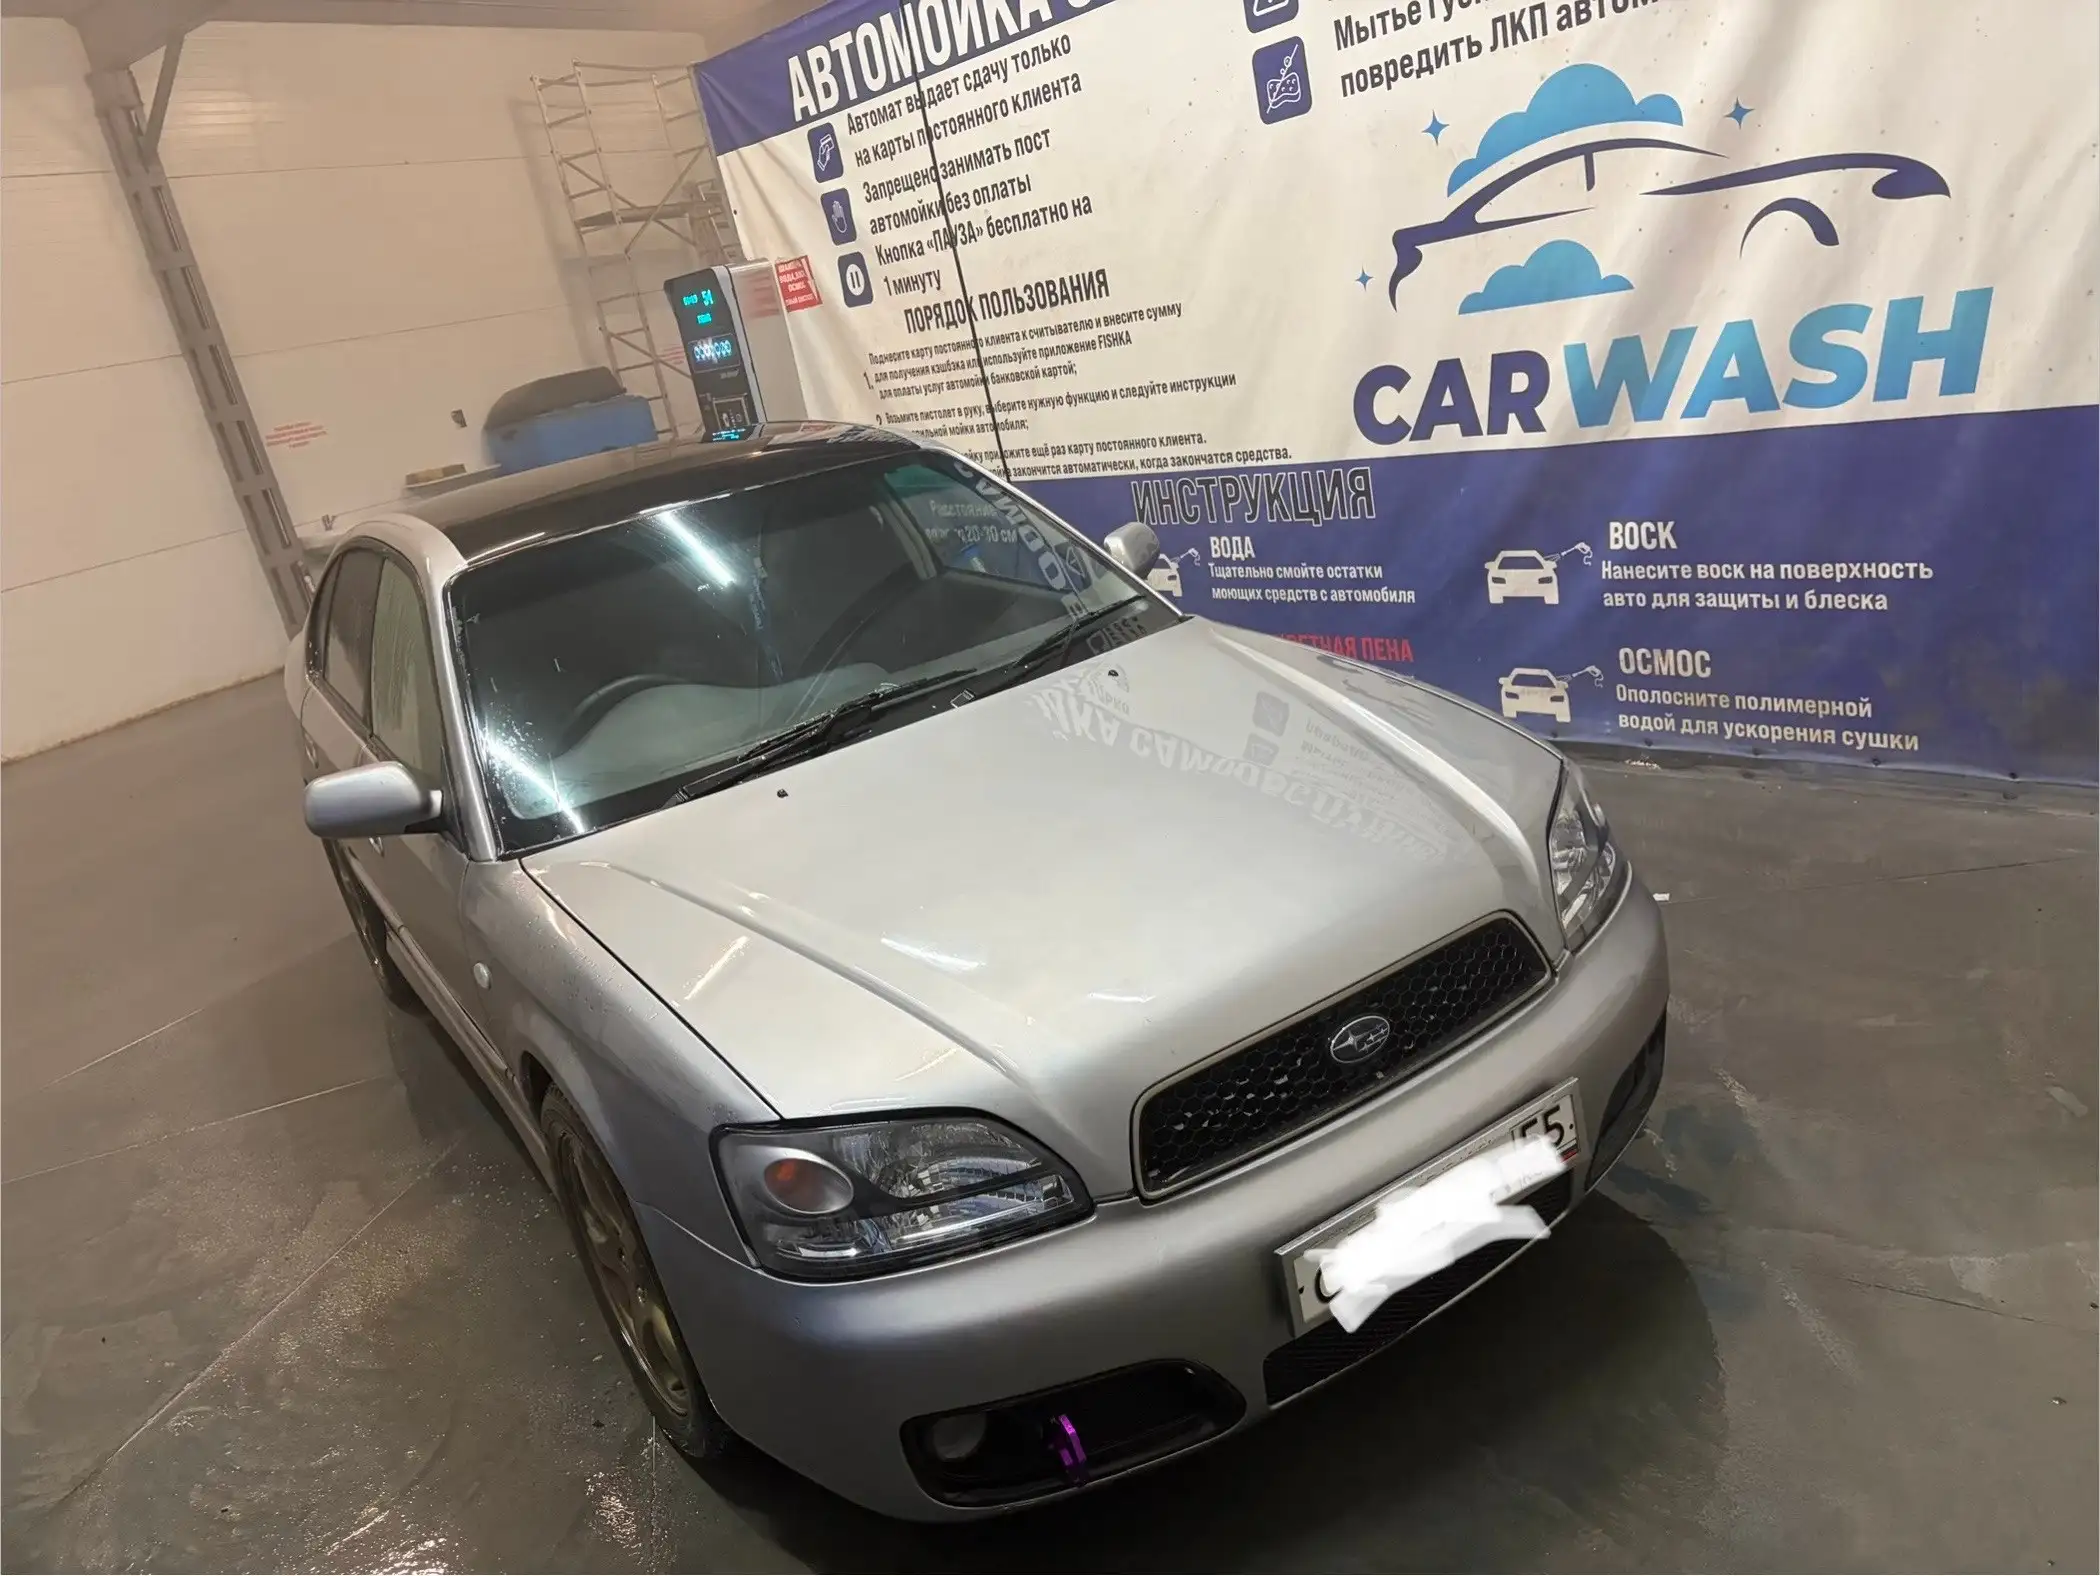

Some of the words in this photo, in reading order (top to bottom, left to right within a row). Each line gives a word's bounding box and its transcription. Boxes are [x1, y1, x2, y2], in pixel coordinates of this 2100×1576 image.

[1333, 0, 1422, 51] Мытье
[1340, 34, 1483, 97] повредить
[1488, 1, 1549, 52] ЛКП
[847, 99, 902, 135] Автомат
[905, 77, 960, 114] выдает
[962, 58, 1008, 92] сдачу
[1010, 34, 1072, 73] только
[855, 149, 871, 168] на
[873, 130, 916, 162] карты
[917, 98, 1010, 143] постоянного
[1011, 72, 1083, 114] клиента
[863, 164, 939, 204] Запрещено
[940, 141, 1013, 181] занимать
[1013, 128, 1051, 157] пост
[870, 198, 946, 236] автомойки
[945, 190, 971, 214] без
[972, 174, 1032, 207] оплаты
[875, 238, 926, 266] Кнопка
[926, 219, 984, 254] «ПАУЗА»
[986, 200, 1069, 240] бесплатно
[1071, 195, 1093, 218] на
[893, 269, 942, 297] минуту
[904, 295, 978, 335] ПОРЯДОК
[978, 268, 1111, 322] ПОЛЬЗОВАНИЯ
[869, 350, 911, 366] Поднесите
[911, 347, 934, 362] карту
[934, 338, 984, 355] постоянноо
[985, 332, 1021, 347] клиента
[1021, 330, 1028, 341] к
[1029, 319, 1094, 341] считывателю
[1095, 317, 1102, 329] и
[1103, 308, 1145, 327] внесите
[1146, 302, 1183, 320] сумму
[875, 370, 888, 383] для
[889, 365, 930, 381] получения
[931, 358, 966, 374] кэшбэка
[983, 347, 1038, 366] используйте
[1038, 340, 1097, 360] приложение
[1097, 330, 1132, 350] FISHKA
[1353, 349, 1550, 446] CAR
[1564, 285, 1994, 428] WASH
[863, 371, 874, 390] 1.
[880, 387, 892, 400] для
[893, 382, 922, 398] оплаты
[923, 381, 946, 397] услуг
[991, 365, 1041, 384] банковской
[1041, 361, 1077, 379] картой;
[885, 411, 919, 425] Возьмите
[920, 407, 956, 422] пистолет
[957, 406, 963, 417] в
[964, 403, 985, 419] руку,
[1028, 394, 1064, 413] нужную
[1065, 387, 1110, 408] функцию
[1111, 388, 1119, 400] и
[1119, 380, 1168, 399] следуйте
[1169, 373, 1237, 395] инструкции
[911, 424, 948, 438] ильной
[949, 421, 975, 435] мойки
[961, 449, 983, 463] ойку
[984, 447, 1031, 463] приожите
[1032, 443, 1049, 458] ещё
[1050, 444, 1066, 459] раз
[1067, 442, 1094, 459] карту
[1096, 436, 1158, 454] постоянного
[1159, 431, 1207, 448] клиента.
[990, 465, 1011, 478] ойка
[1012, 463, 1061, 477] закончится
[1063, 457, 1139, 475] автоматически,
[1140, 457, 1168, 473] когда
[1170, 450, 1235, 467] закончатся
[1236, 447, 1292, 465] средства.
[1130, 466, 1377, 528] ИНСТРУКЦИЯ
[1209, 536, 1256, 561] ВОДА
[1608, 521, 1678, 550] ВОСК
[1208, 563, 1274, 580] Тщательно
[1276, 562, 1325, 580] смойте
[1326, 563, 1383, 579] остатки
[1601, 560, 1692, 580] Нанесите
[1697, 564, 1746, 580] воск
[1750, 563, 1775, 580] на
[1779, 561, 1934, 584] поверхность
[1212, 587, 1263, 602] моющих
[1265, 587, 1318, 605] средств
[1320, 589, 1328, 603] с
[1331, 586, 1416, 604] автомобиля
[1603, 590, 1647, 608] авто
[1651, 591, 1691, 610] для
[1695, 592, 1781, 612] защиты
[1786, 593, 1799, 609] и
[1804, 589, 1889, 612] блеска
[1279, 634, 1357, 661] ТНАЯ
[1361, 637, 1414, 663] ПЕНА
[1619, 647, 1712, 679] ОСМОС
[1615, 683, 1731, 709] Ополосните
[1734, 695, 1874, 719] полимерной
[1618, 713, 1676, 733] водой
[1680, 718, 1719, 737] для
[1723, 721, 1837, 746] ускорения
[1842, 730, 1920, 752] сушки
